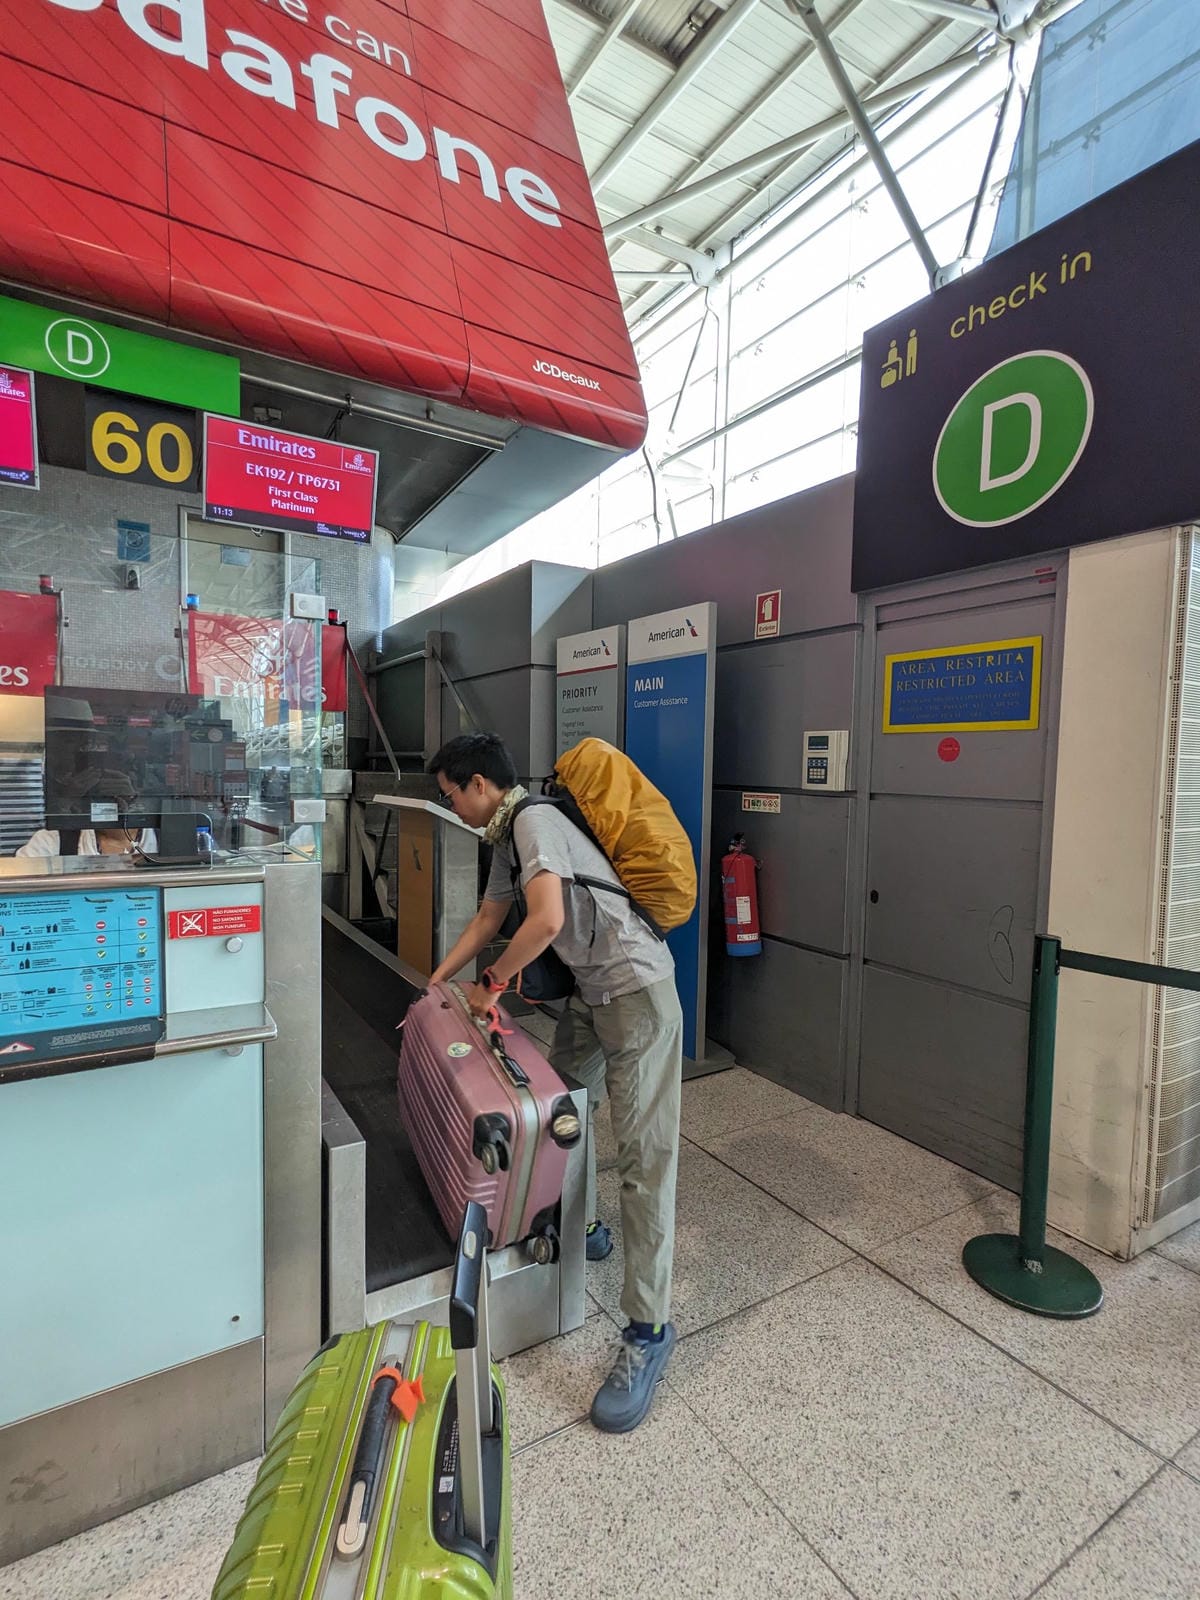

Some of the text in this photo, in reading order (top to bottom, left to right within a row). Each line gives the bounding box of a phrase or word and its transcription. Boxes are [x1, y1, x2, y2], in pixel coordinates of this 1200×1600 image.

[324, 15, 412, 76] can
[52, 0, 562, 228] dafone
[950, 251, 1093, 339] check in
[67, 329, 94, 366] D
[532, 359, 602, 391] JCDecaux
[0, 386, 26, 398] irates
[91, 410, 194, 484] 60
[238, 428, 316, 459] Emirates
[979, 392, 1042, 493] D
[246, 462, 286, 482] EK192
[296, 472, 341, 492] TP6731
[268, 485, 319, 504] First Class
[213, 506, 233, 517] 11:13
[271, 498, 315, 515] Platinum
[648, 626, 685, 643] American
[572, 647, 601, 660] American
[946, 652, 1025, 671] RESTRITA
[634, 676, 664, 693] MAIN
[896, 670, 1025, 692] RESTRICTED AREA
[562, 686, 598, 700] PRIORITY
[634, 696, 689, 709] Customer Assistance
